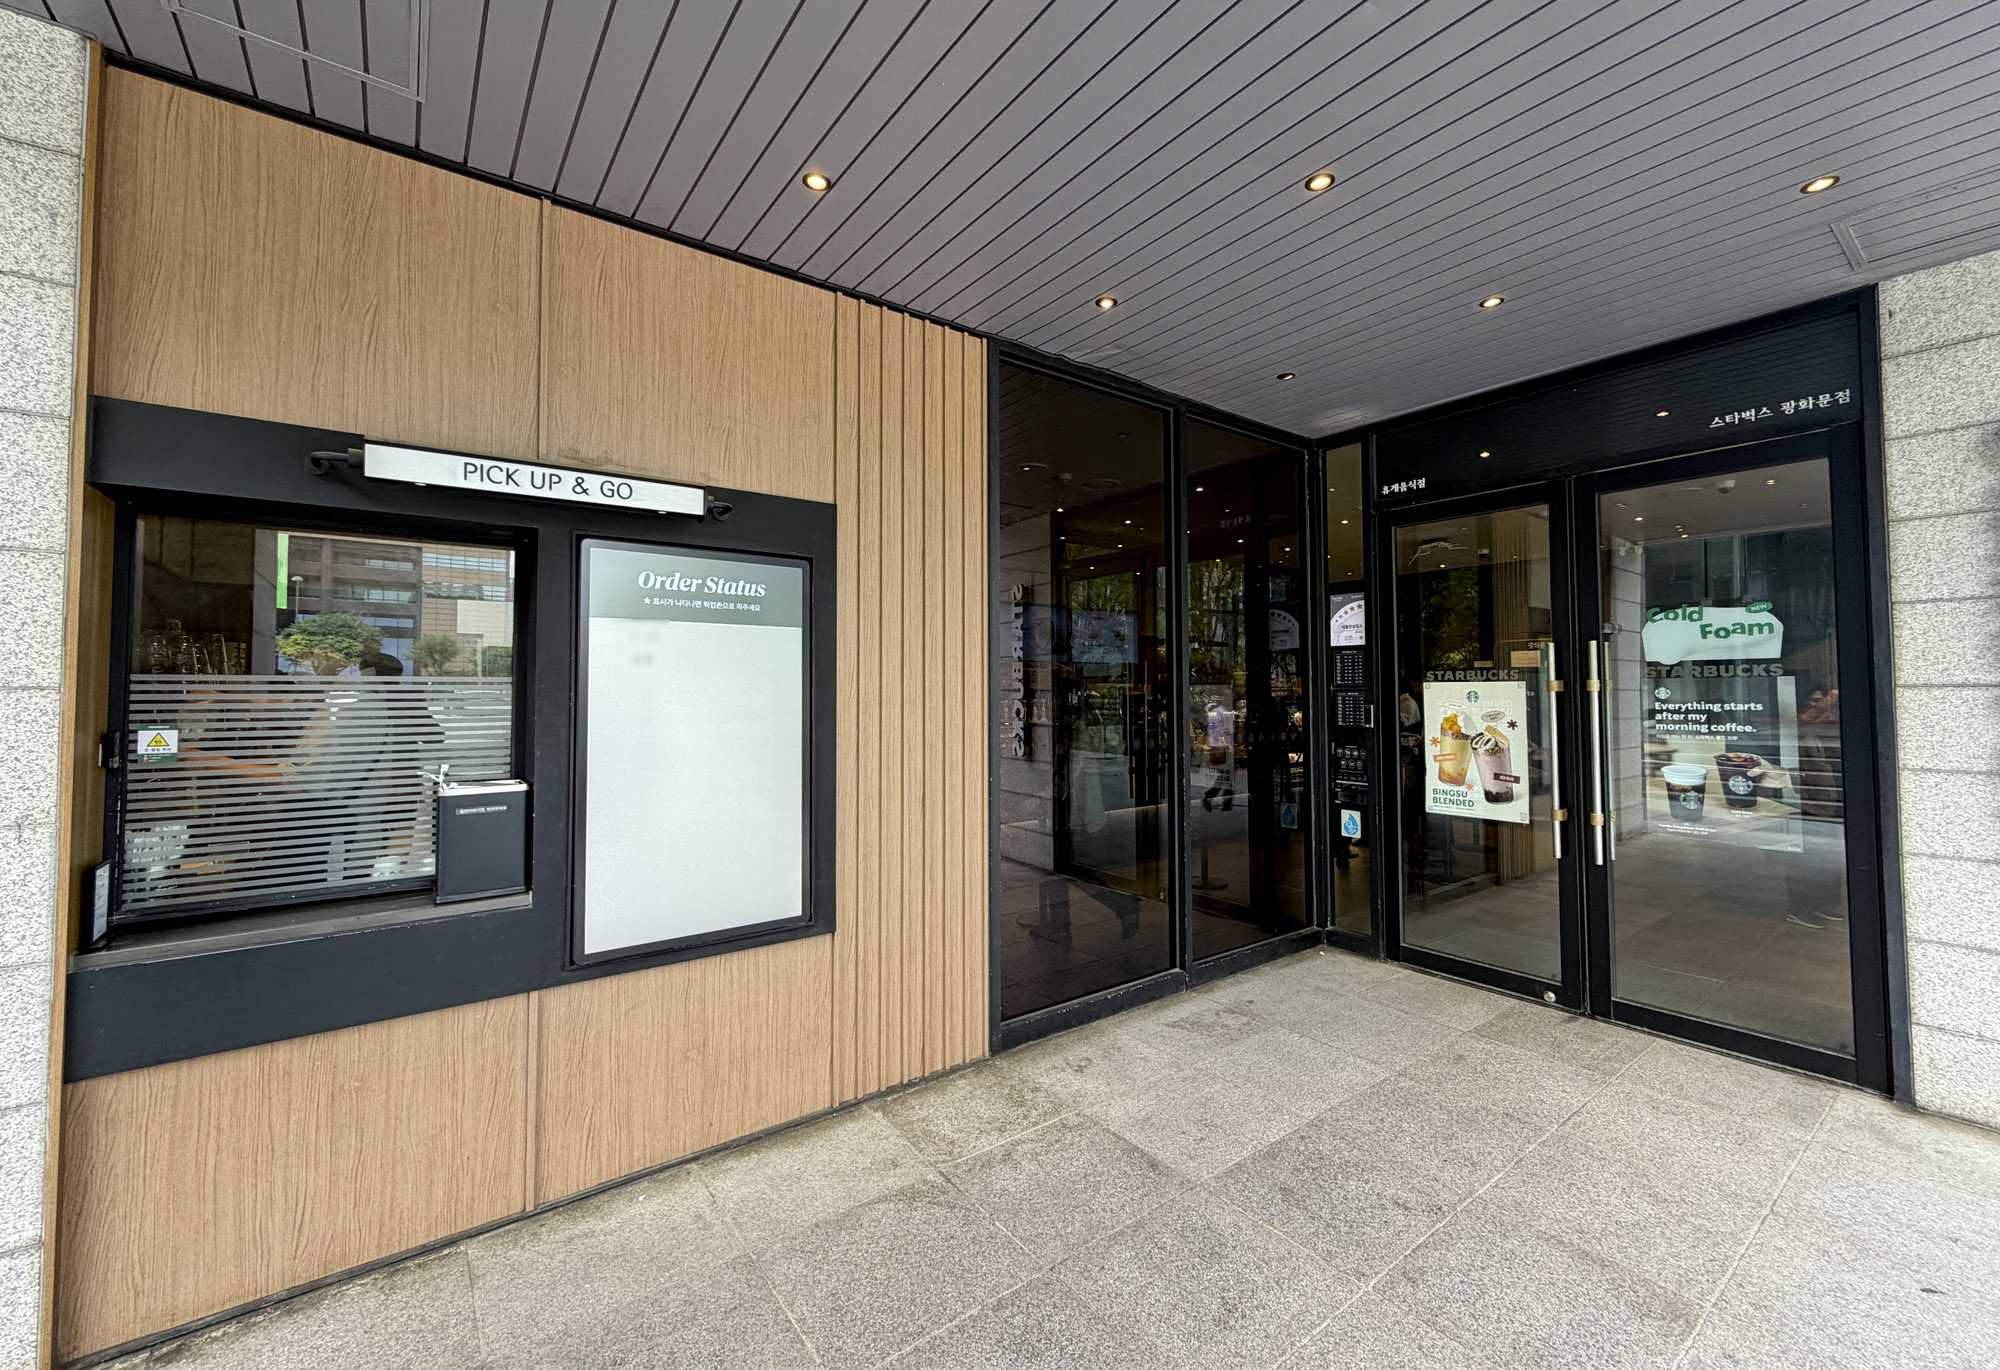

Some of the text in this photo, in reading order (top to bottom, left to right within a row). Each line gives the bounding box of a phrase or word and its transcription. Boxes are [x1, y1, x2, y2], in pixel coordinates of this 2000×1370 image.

[1709, 388, 1850, 428] 스타벅스 광화문점
[463, 462, 633, 500] PICK UP & GO
[1381, 477, 1426, 495] 휴게음식점
[638, 571, 767, 598] Order Status
[652, 597, 674, 606] 표시가
[703, 601, 735, 610] 픽업존으로
[1751, 603, 1769, 611] NEW
[1647, 604, 1704, 624] Cold
[1700, 622, 1775, 639] Foam
[1426, 669, 1520, 681] STARBUCKS
[1646, 664, 1784, 678] STARBUCKS
[1654, 701, 1764, 713] Everything starts
[1655, 711, 1708, 722] after my
[1656, 722, 1757, 733] morning coffee.
[1432, 788, 1468, 798] BINGSU
[1432, 796, 1475, 808] BLENDED
